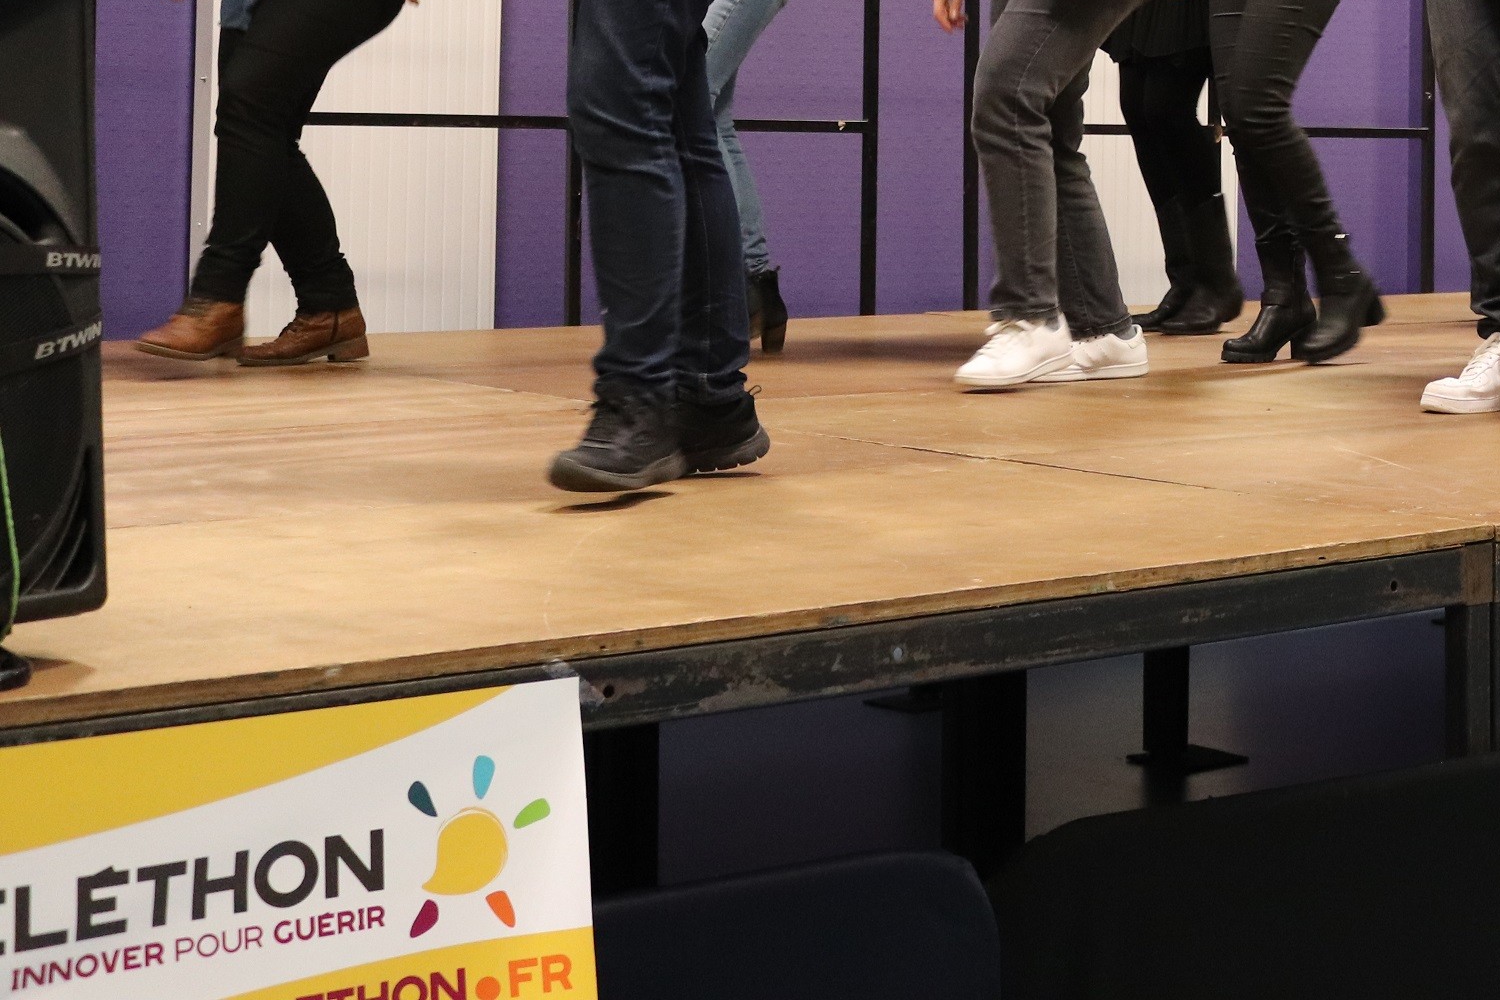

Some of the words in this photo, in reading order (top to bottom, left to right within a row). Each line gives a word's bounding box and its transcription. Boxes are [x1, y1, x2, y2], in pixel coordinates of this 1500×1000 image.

[46, 252, 101, 268] BTWI
[34, 321, 101, 360] BTWIN
[0, 829, 385, 955] LÉTHON
[11, 943, 164, 991] INNOVER
[174, 925, 264, 962] POUR
[273, 905, 385, 944] GUÉRIR
